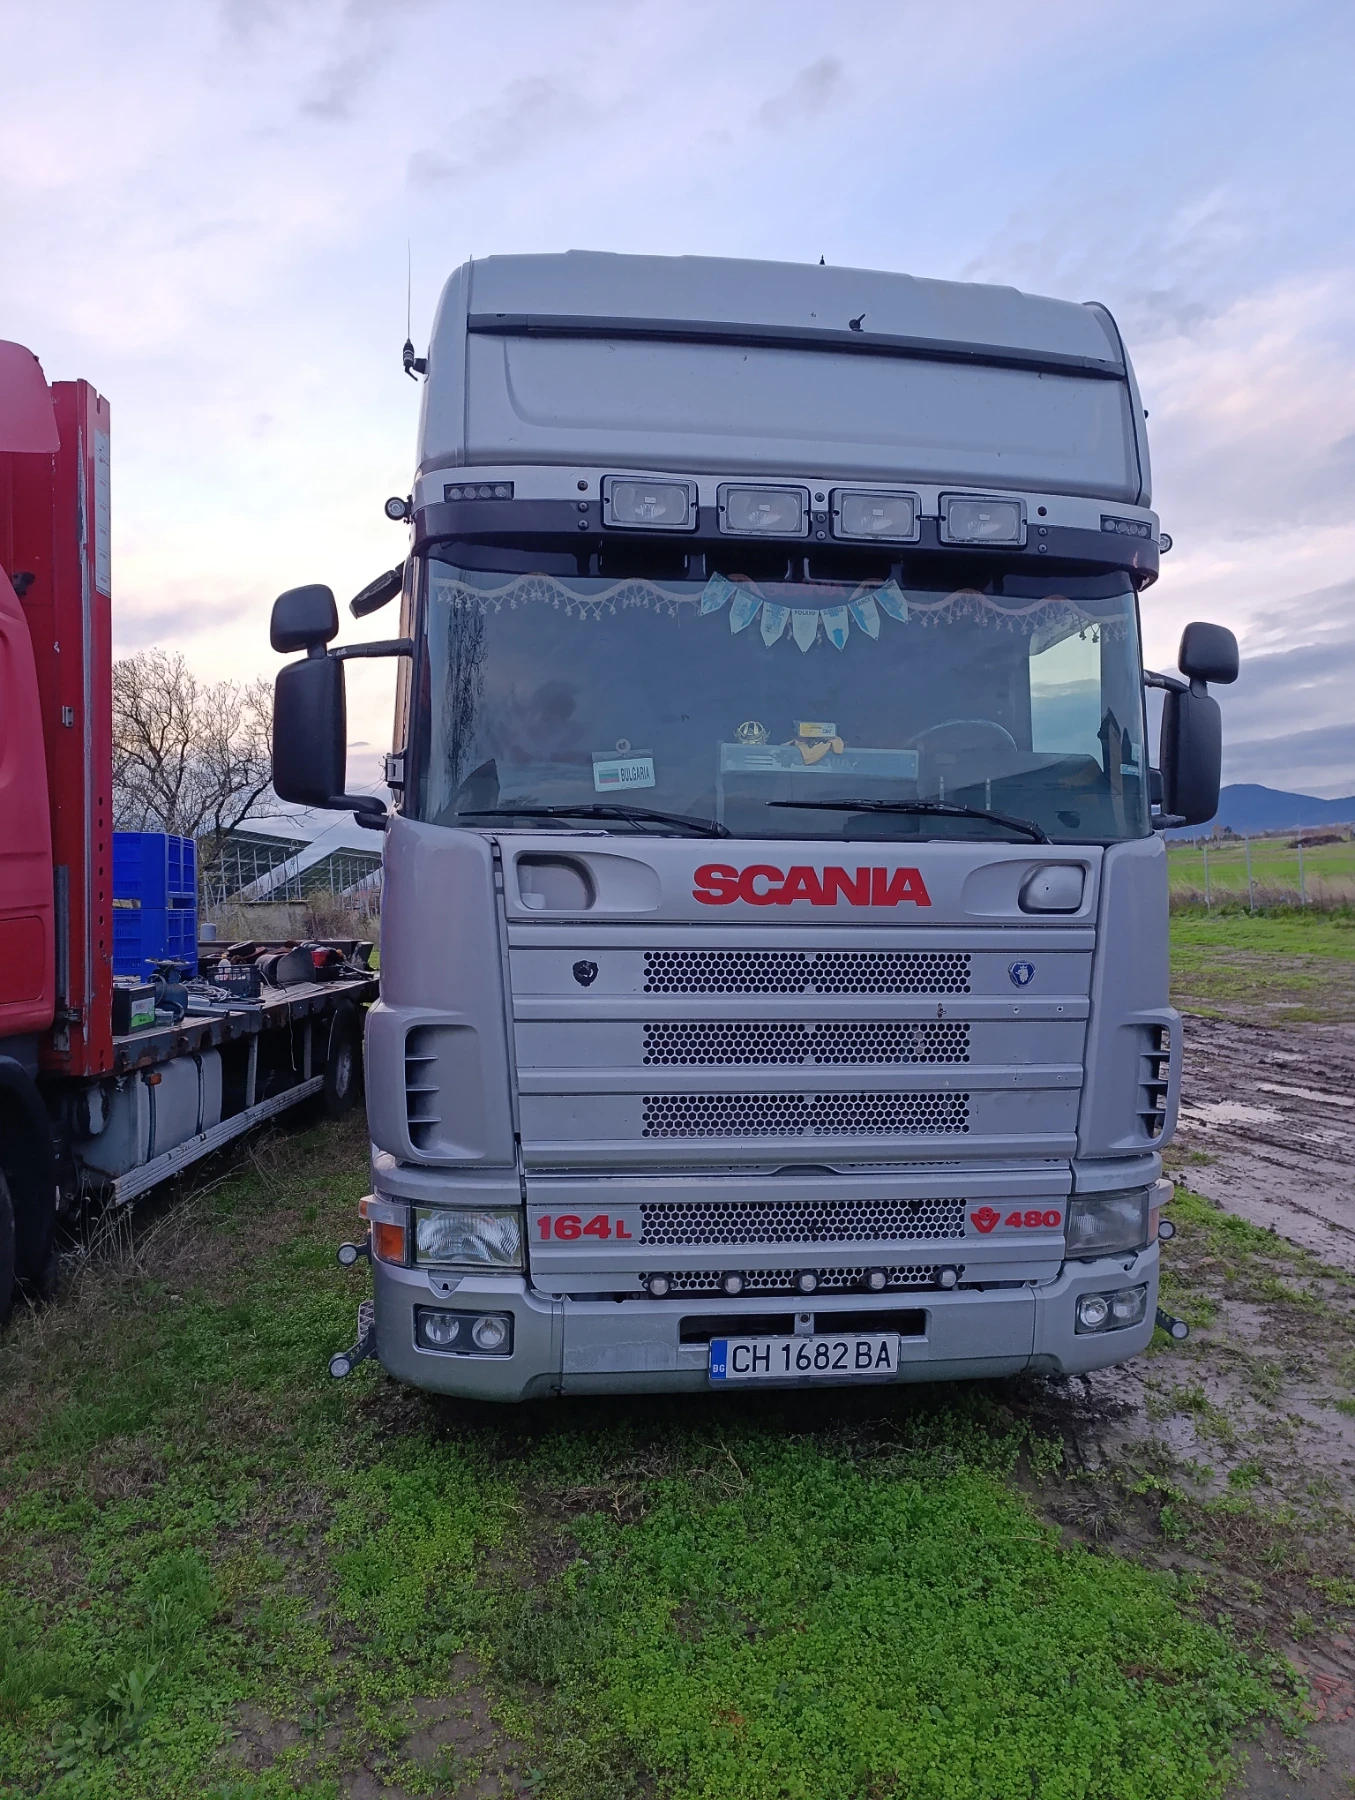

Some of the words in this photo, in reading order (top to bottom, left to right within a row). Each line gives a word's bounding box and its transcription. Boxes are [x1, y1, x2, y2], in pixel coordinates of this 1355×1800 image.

[620, 766, 651, 782] BULGARIA
[692, 863, 932, 906] SCANIA
[1004, 1210, 1062, 1228] 480
[732, 1344, 770, 1373] CH
[781, 1342, 848, 1371] 1682
[855, 1340, 891, 1369] BA
[712, 1364, 725, 1373] BG
